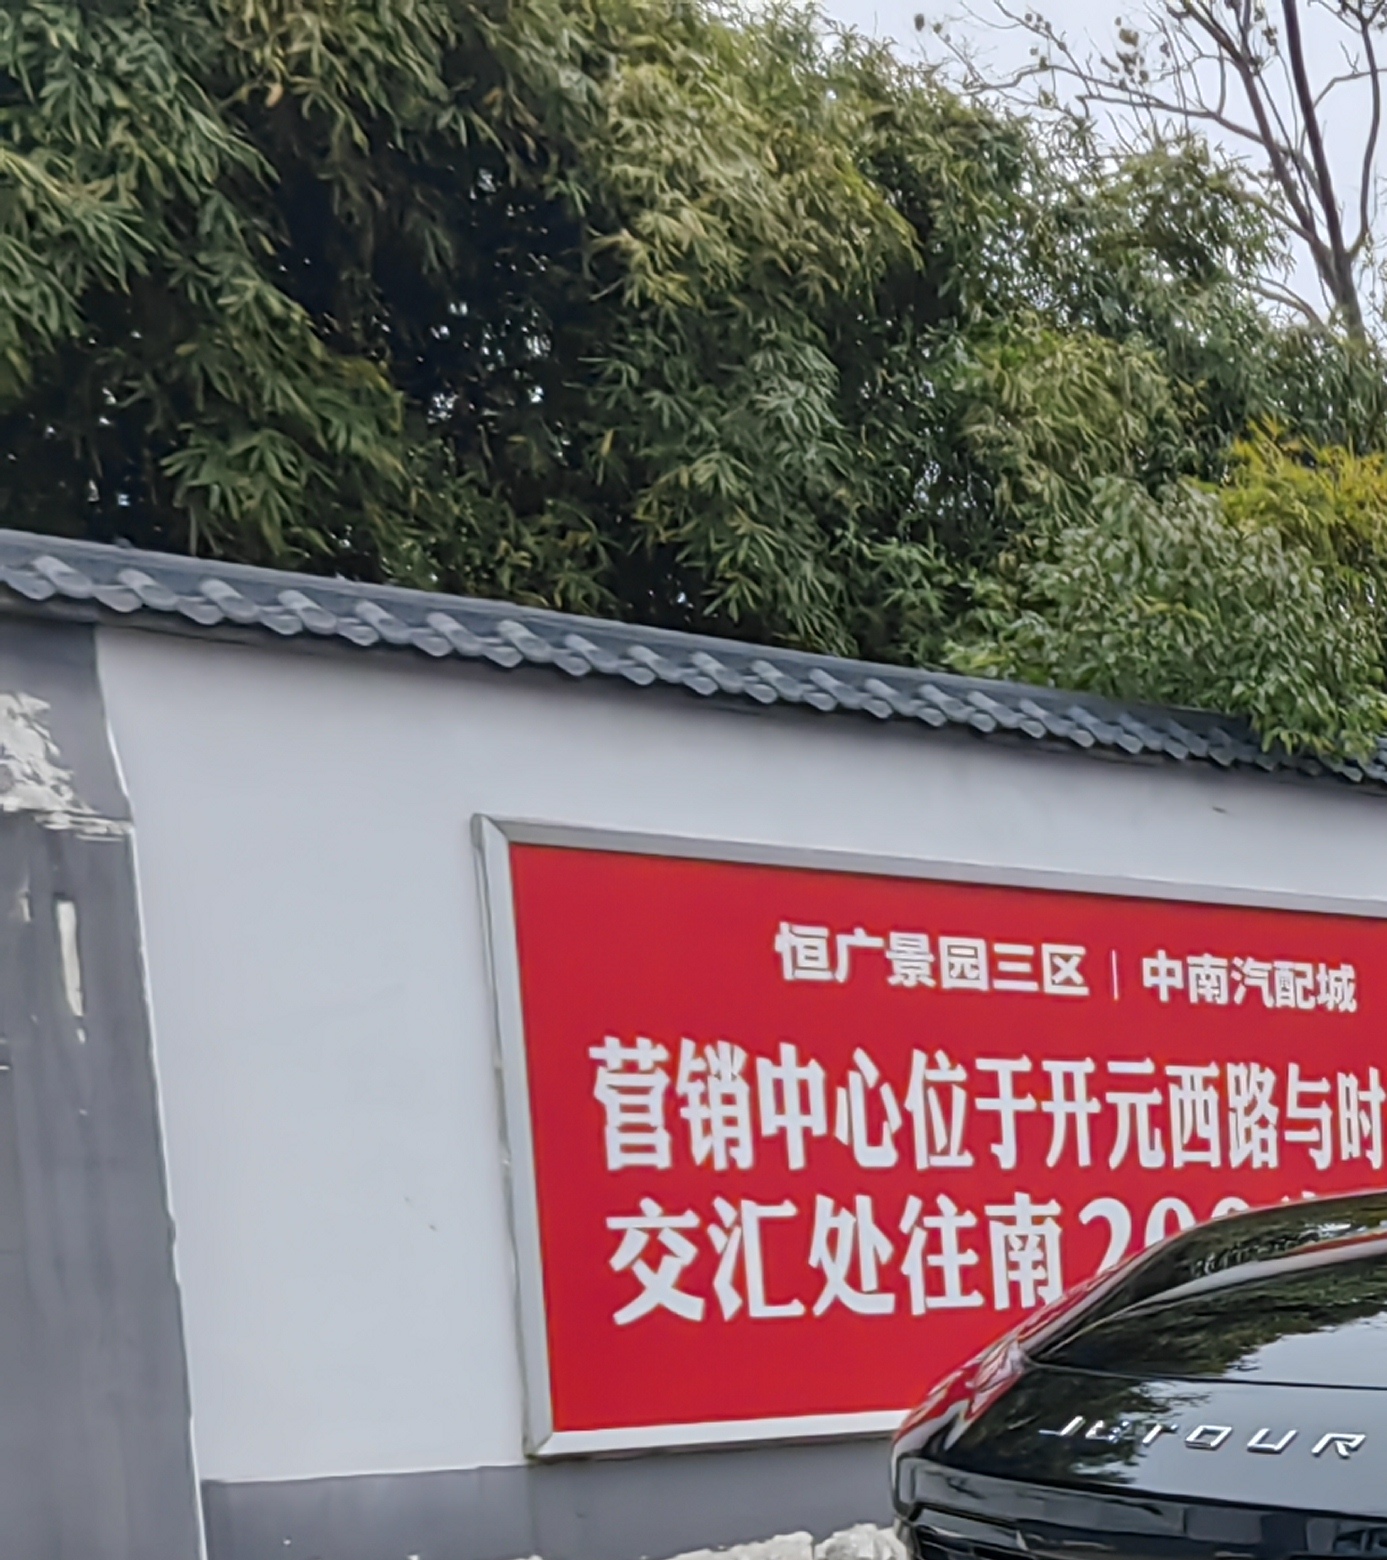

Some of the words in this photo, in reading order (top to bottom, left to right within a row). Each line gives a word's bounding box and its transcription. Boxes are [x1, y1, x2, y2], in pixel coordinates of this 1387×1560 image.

[774, 921, 1090, 996] 恒广景园三区
[1141, 948, 1358, 1013] 中南汽配城
[1039, 1414, 1367, 1460] JETOUR
